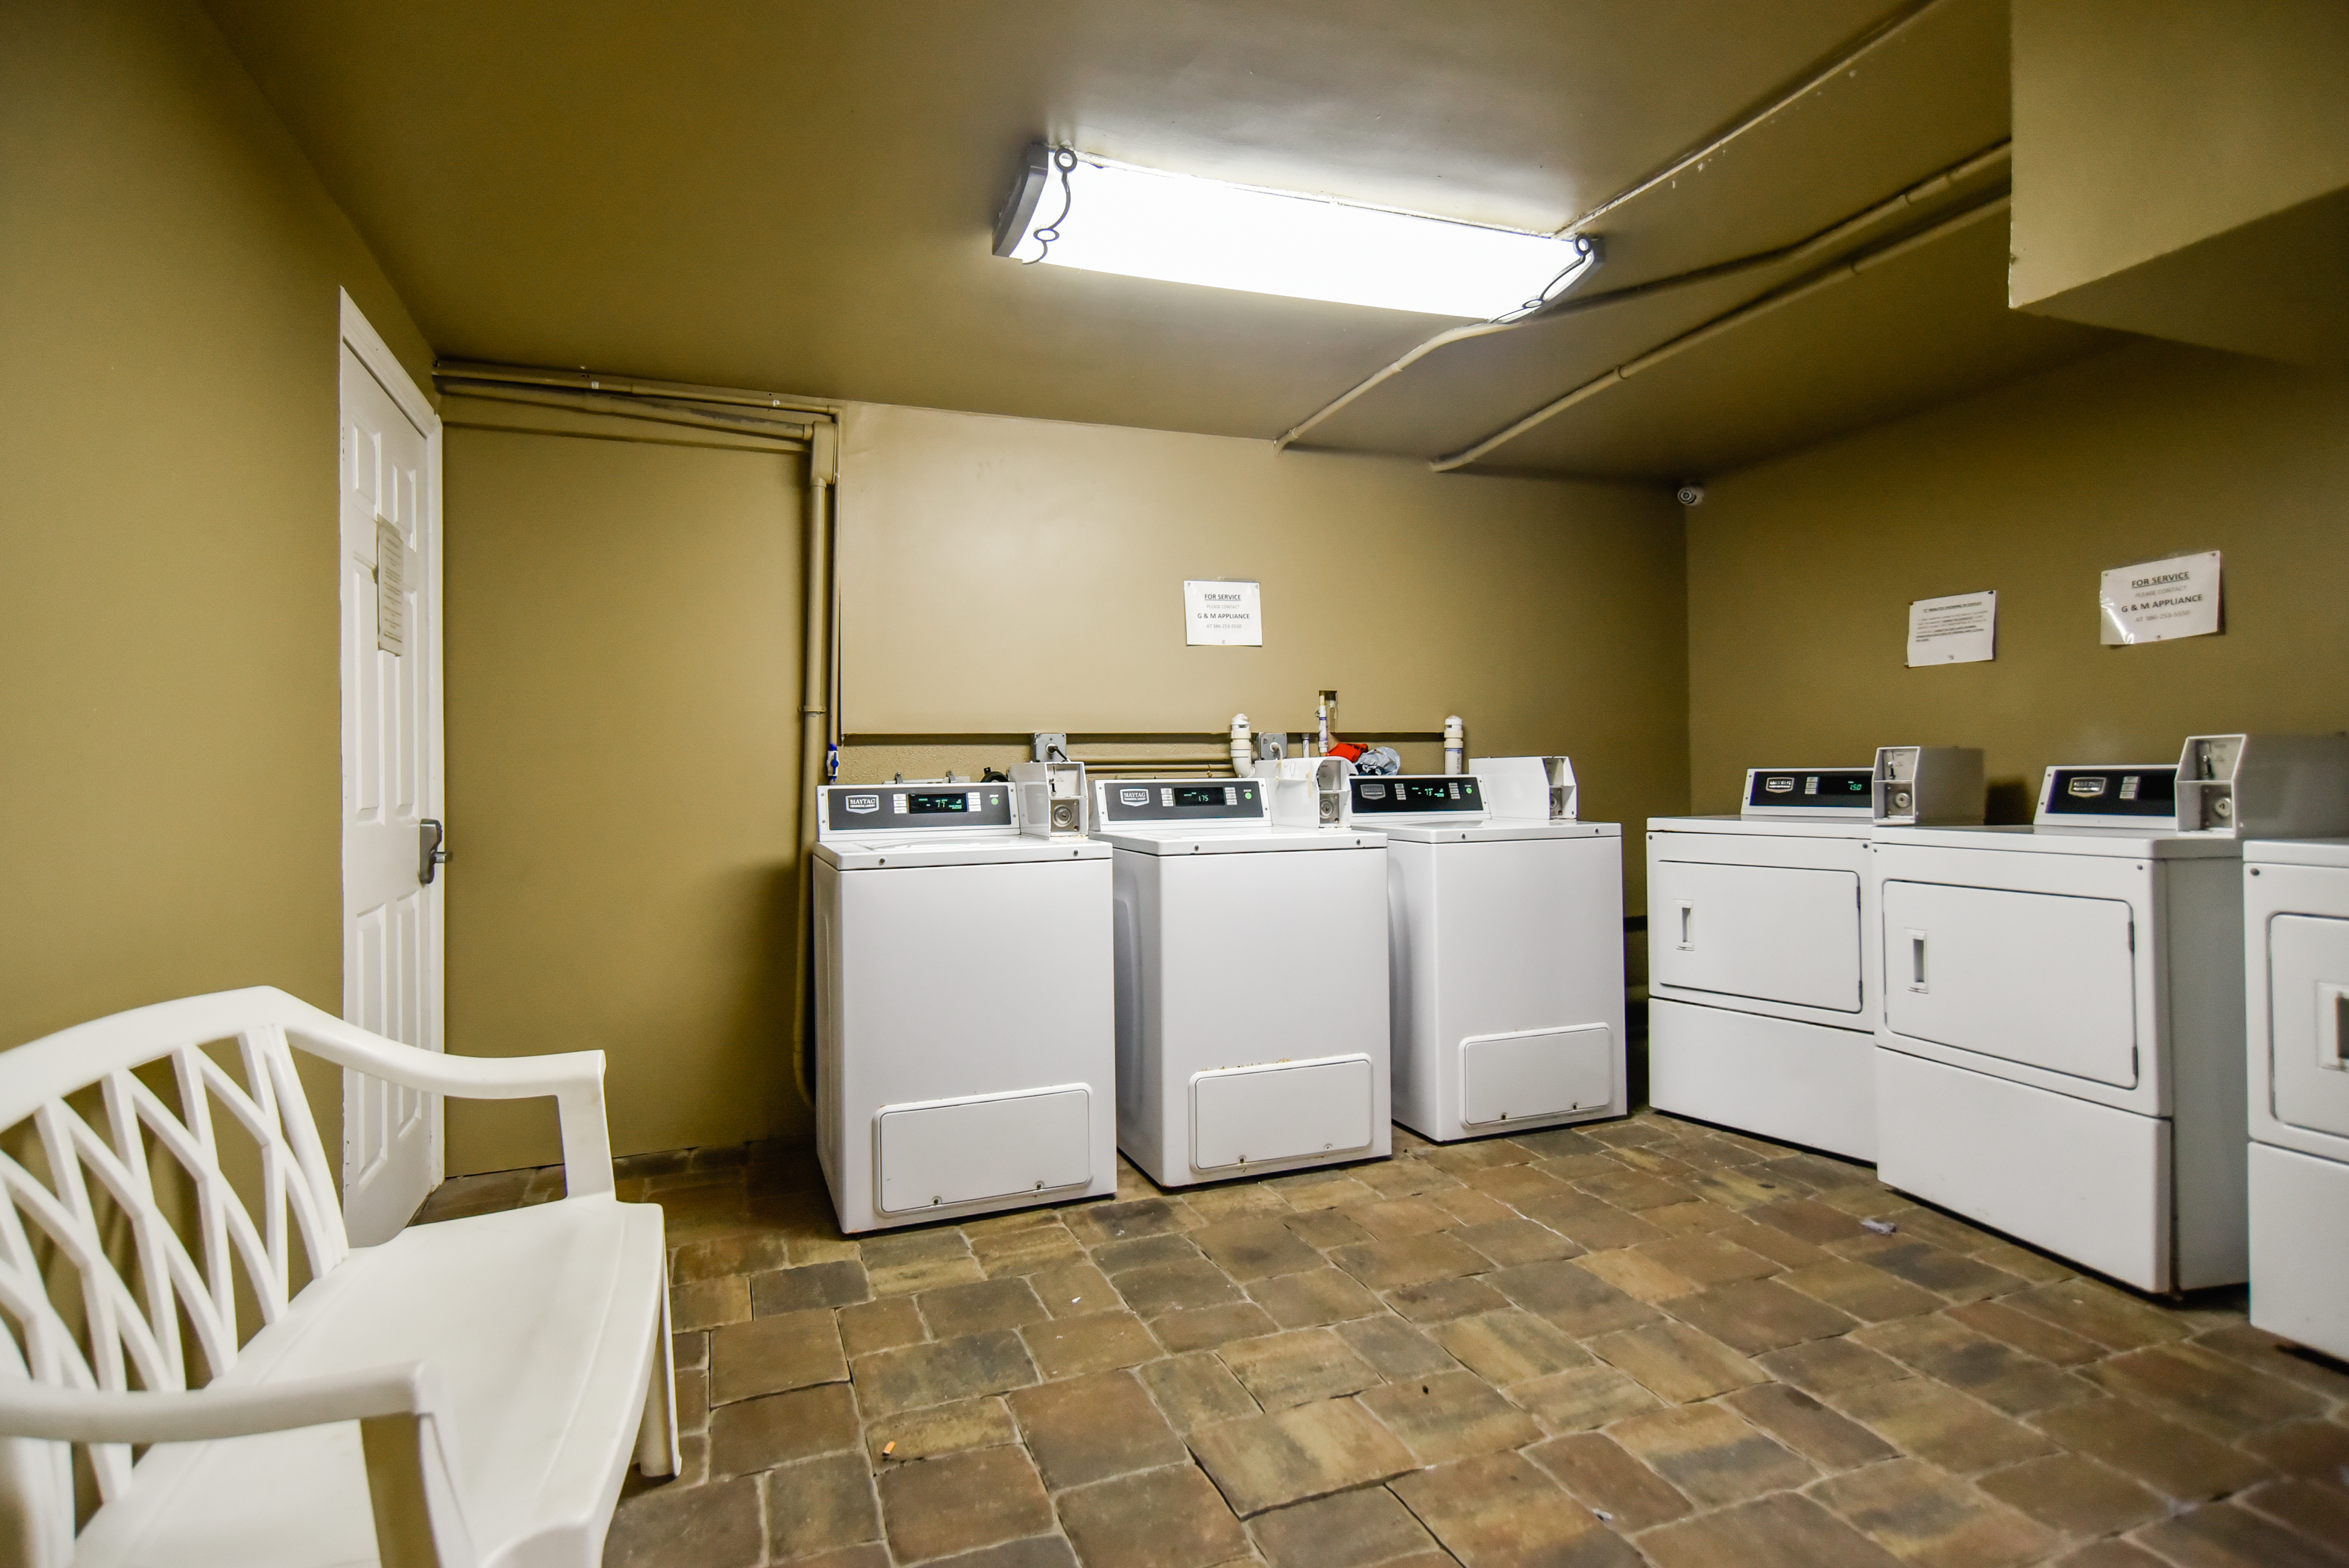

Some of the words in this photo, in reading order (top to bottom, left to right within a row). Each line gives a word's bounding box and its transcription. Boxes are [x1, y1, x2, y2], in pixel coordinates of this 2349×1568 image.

[2132, 578, 2149, 588] FOR
[2152, 572, 2189, 584] SERVICE
[2157, 586, 2187, 595] CONTACT
[2152, 594, 2203, 608] APPLIANCE
